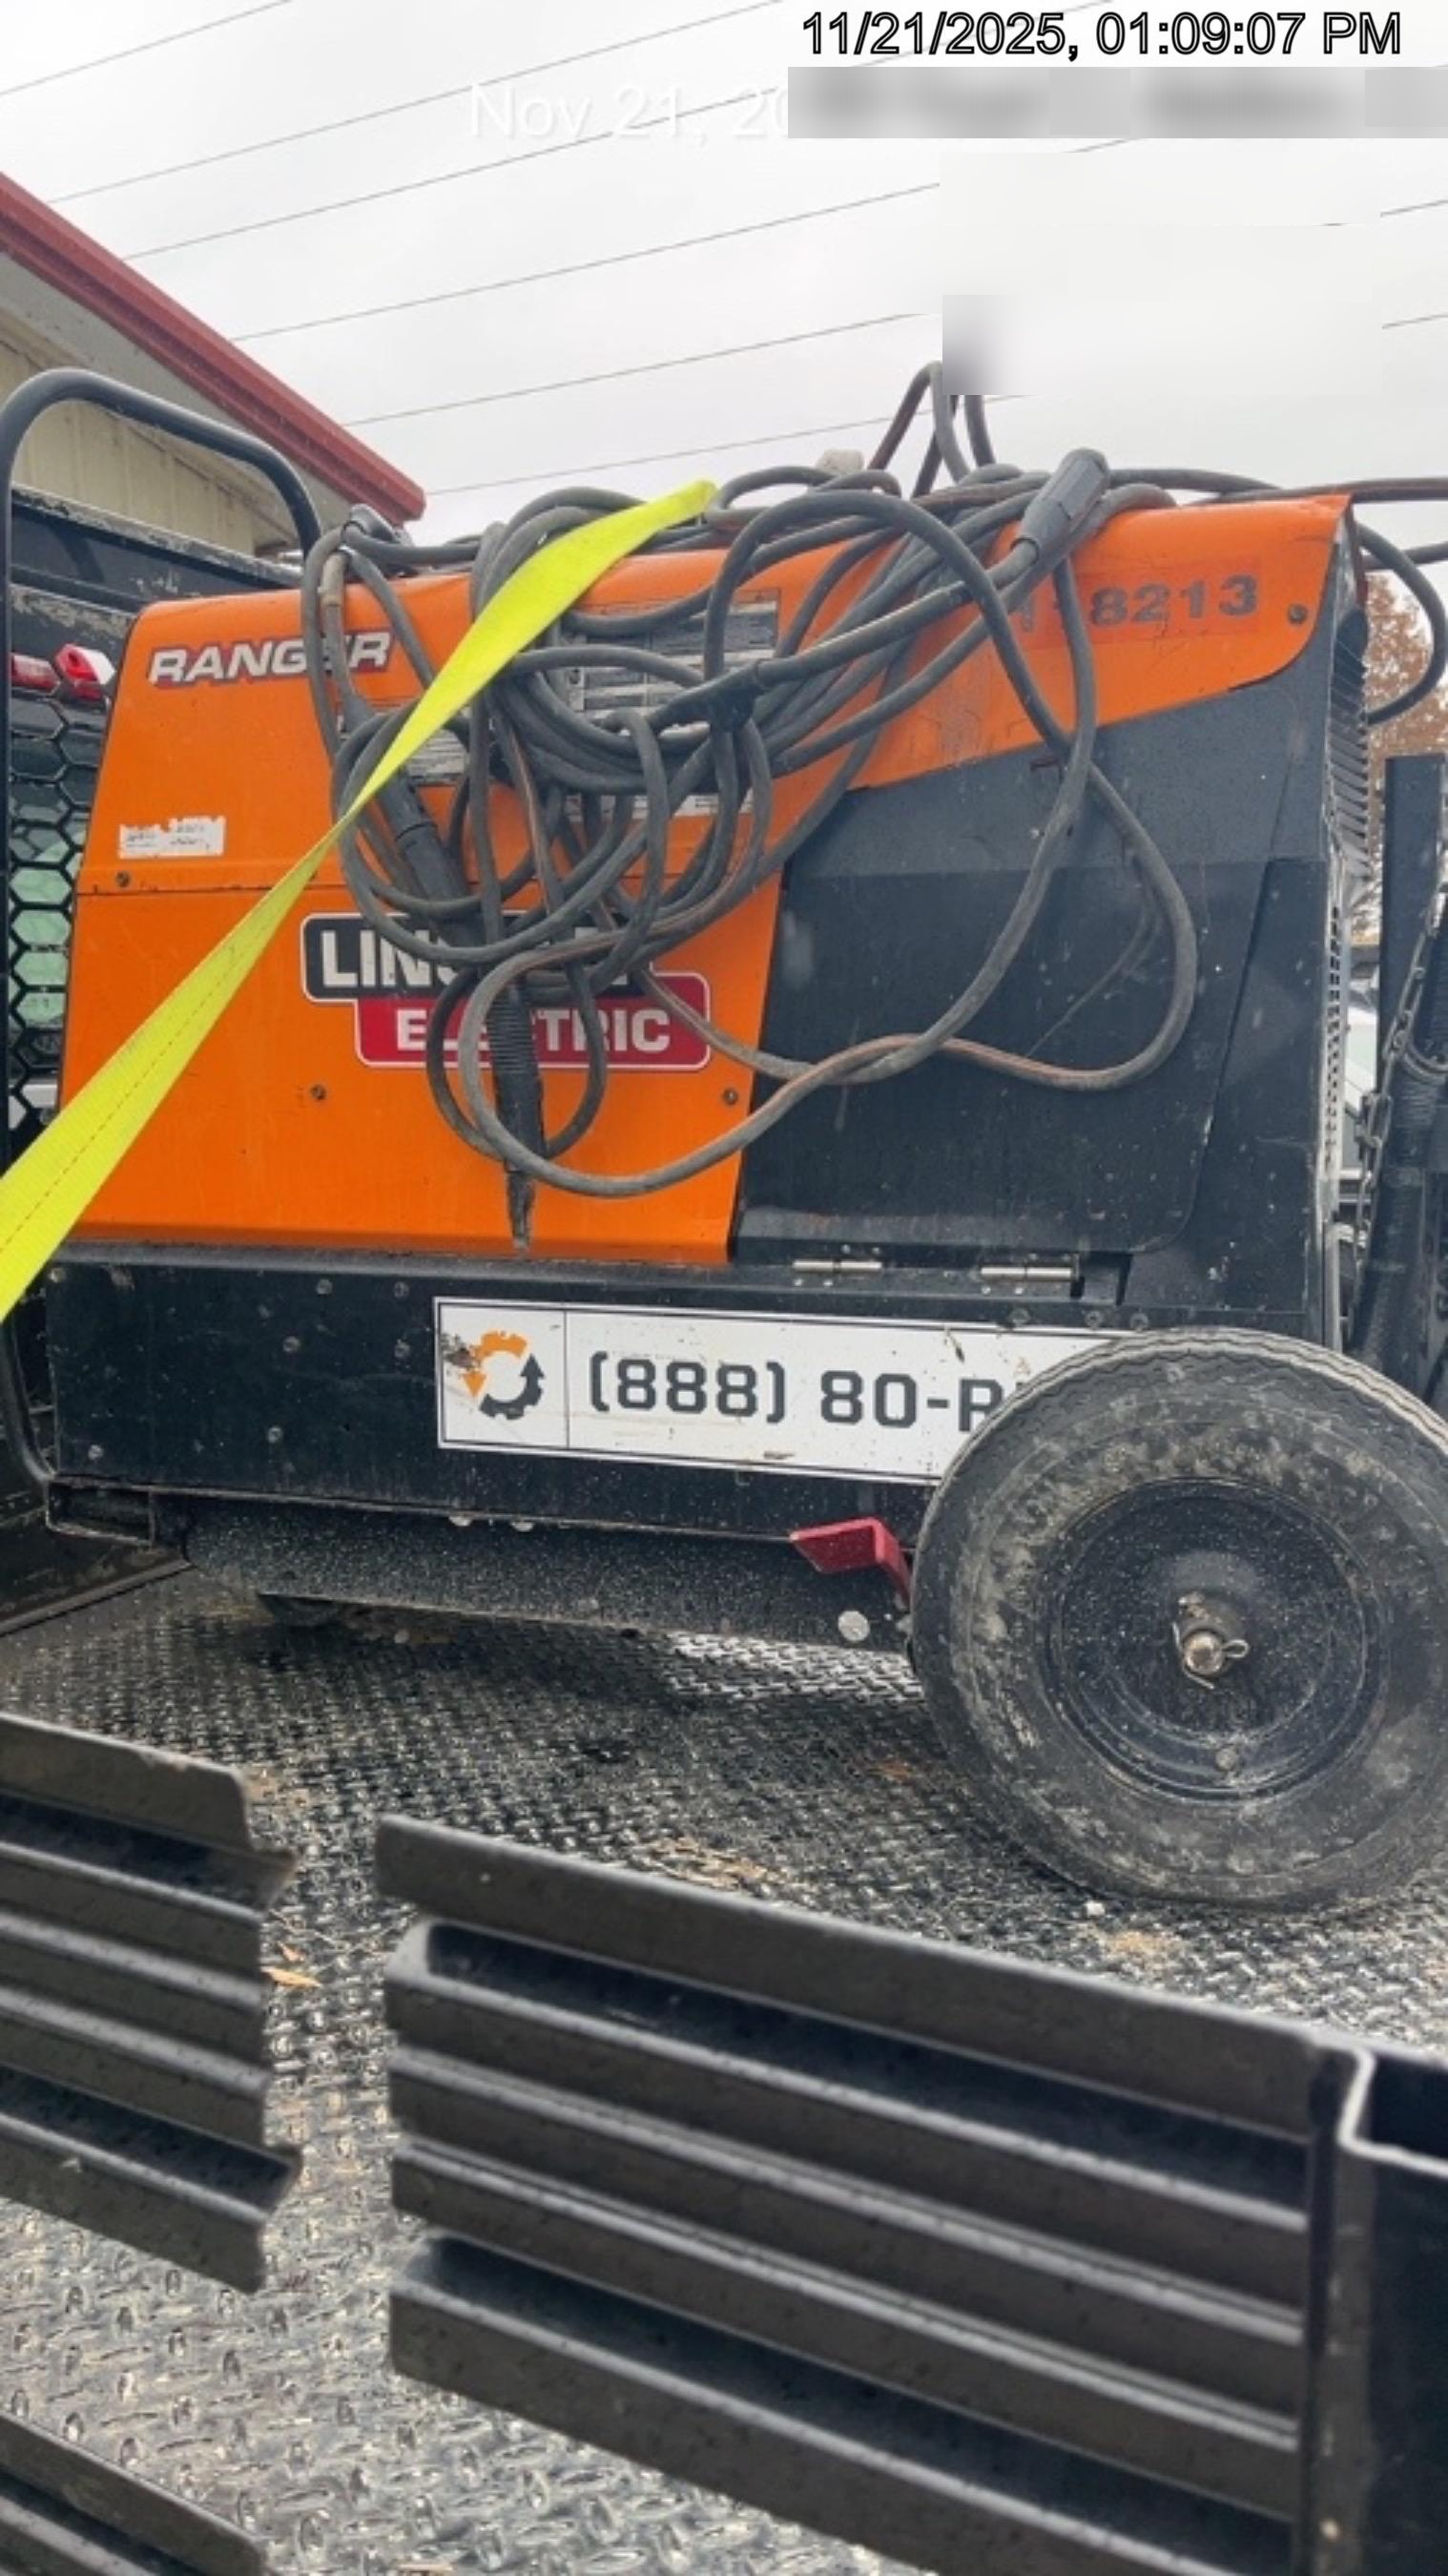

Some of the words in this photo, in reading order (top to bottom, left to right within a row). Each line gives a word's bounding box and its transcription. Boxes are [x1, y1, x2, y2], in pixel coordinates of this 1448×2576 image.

[148, 631, 392, 684] RANGR
[590, 1350, 786, 1424] (888)
[820, 1369, 1026, 1433] 80-R
